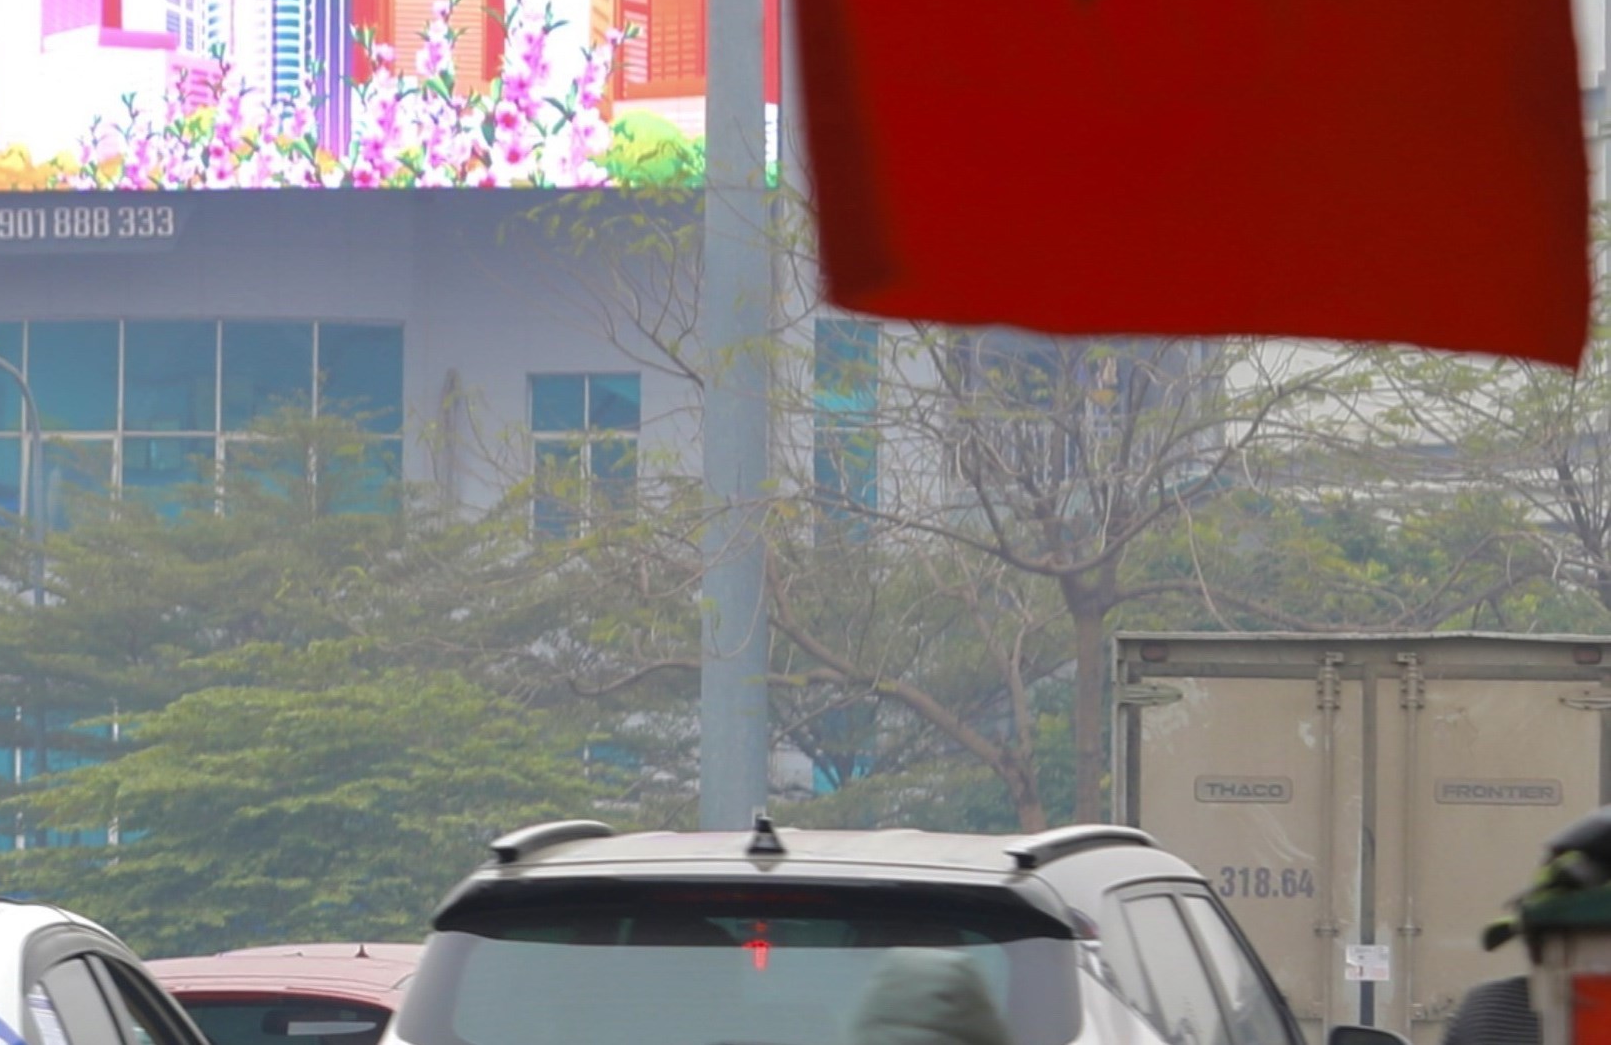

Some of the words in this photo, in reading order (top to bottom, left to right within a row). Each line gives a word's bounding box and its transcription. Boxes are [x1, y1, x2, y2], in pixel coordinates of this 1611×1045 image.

[53, 207, 111, 239] 888
[117, 206, 175, 238] 333
[1205, 781, 1285, 798] THACO
[1441, 784, 1554, 800] FRONTIER
